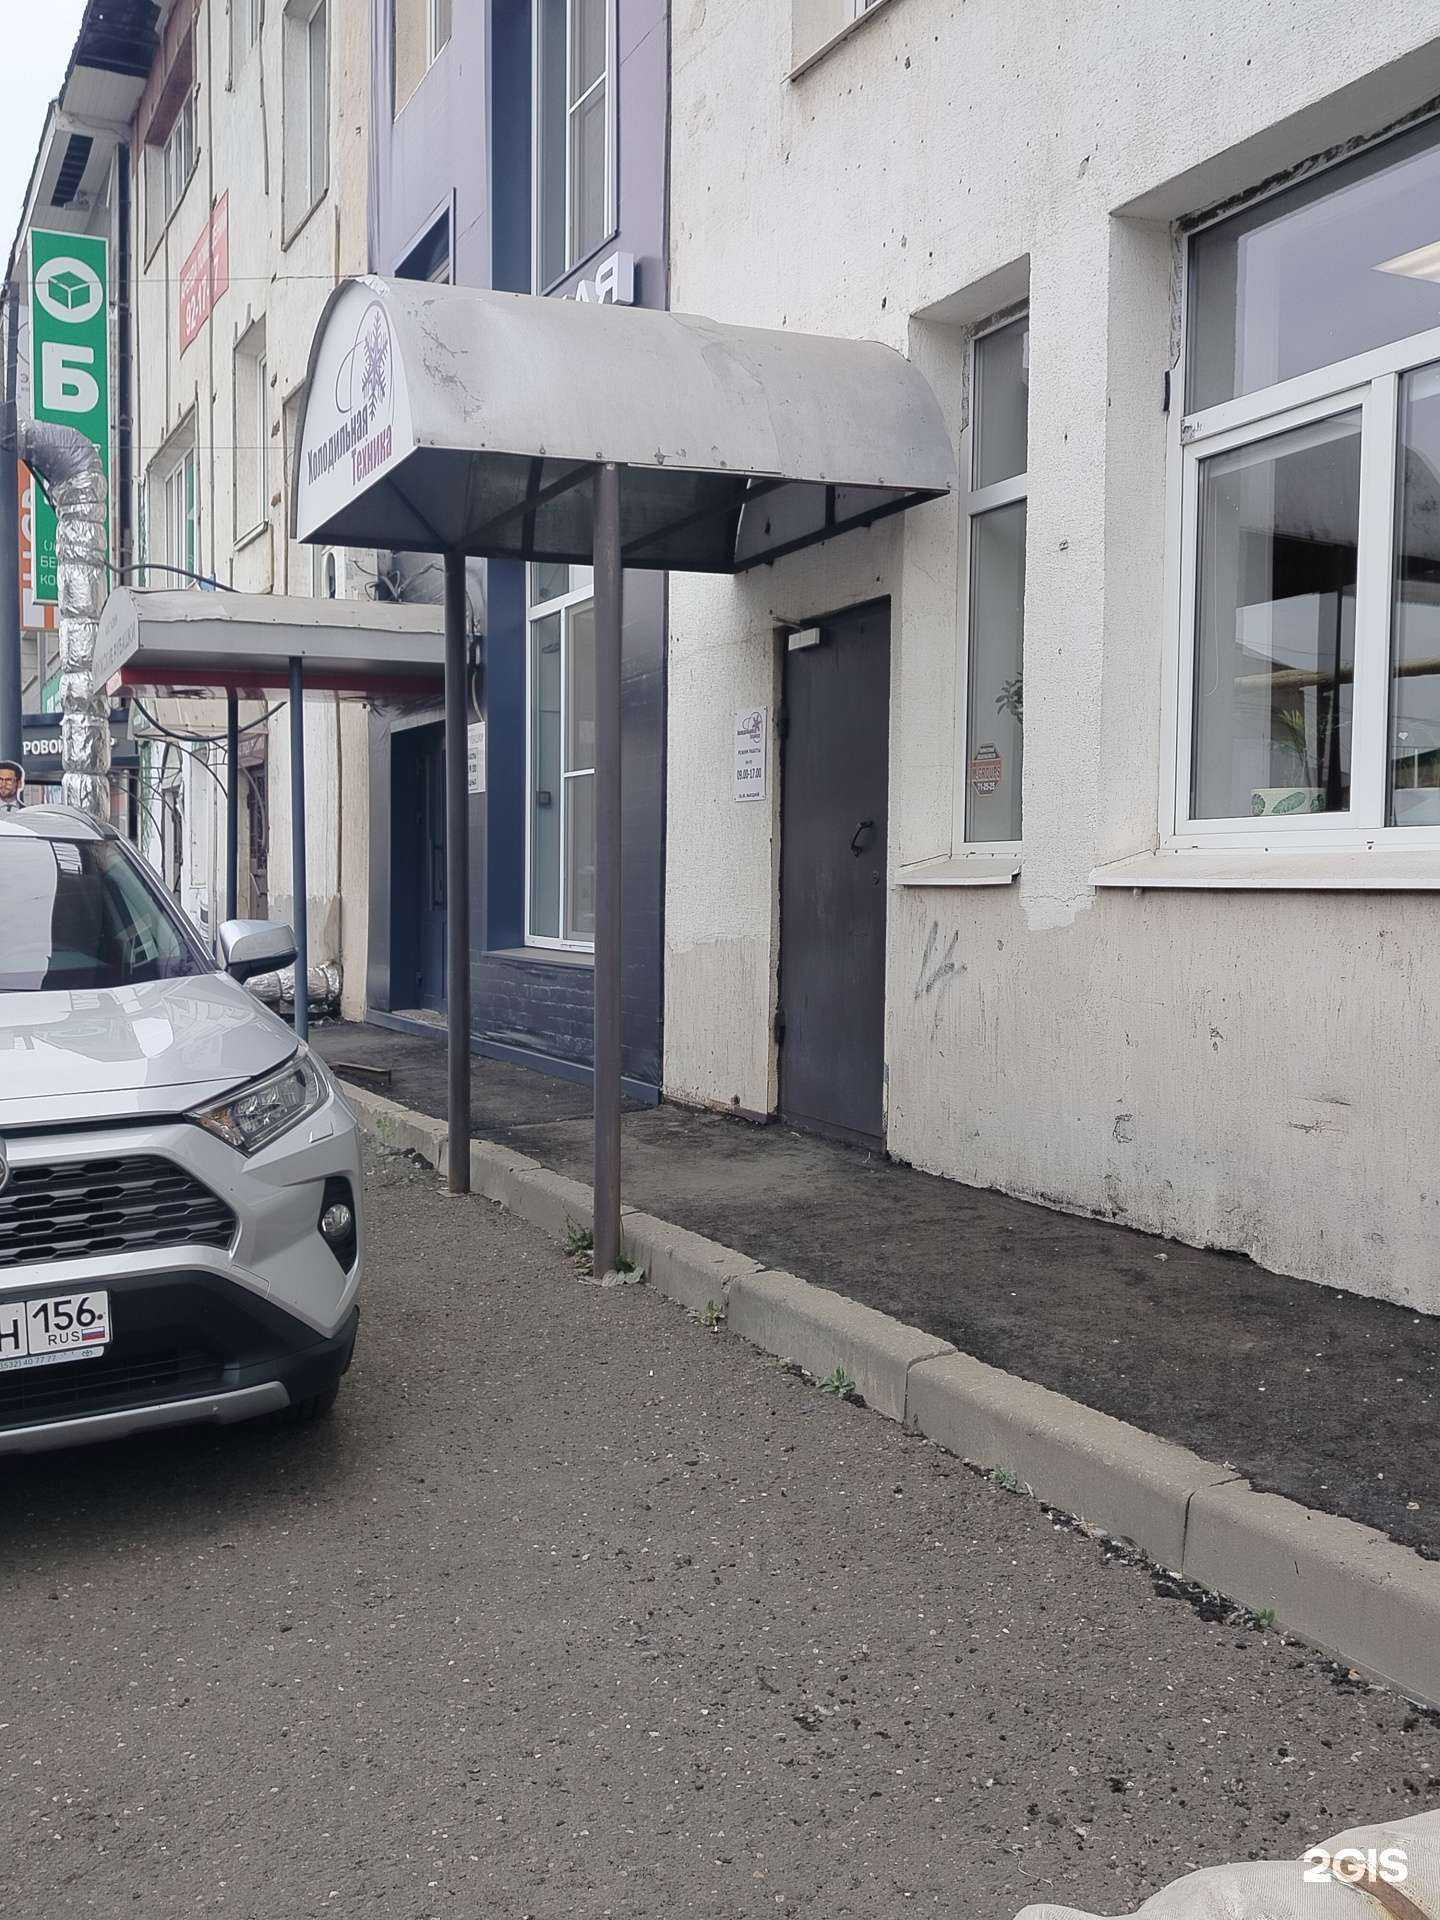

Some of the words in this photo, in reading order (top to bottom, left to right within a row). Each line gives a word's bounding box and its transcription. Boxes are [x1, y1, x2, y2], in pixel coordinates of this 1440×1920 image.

[308, 403, 368, 486] Холодильная
[40, 556, 57, 568] БЕ
[40, 574, 57, 586] КО
[32, 1297, 96, 1333] 156
[47, 1331, 81, 1345] RUS
